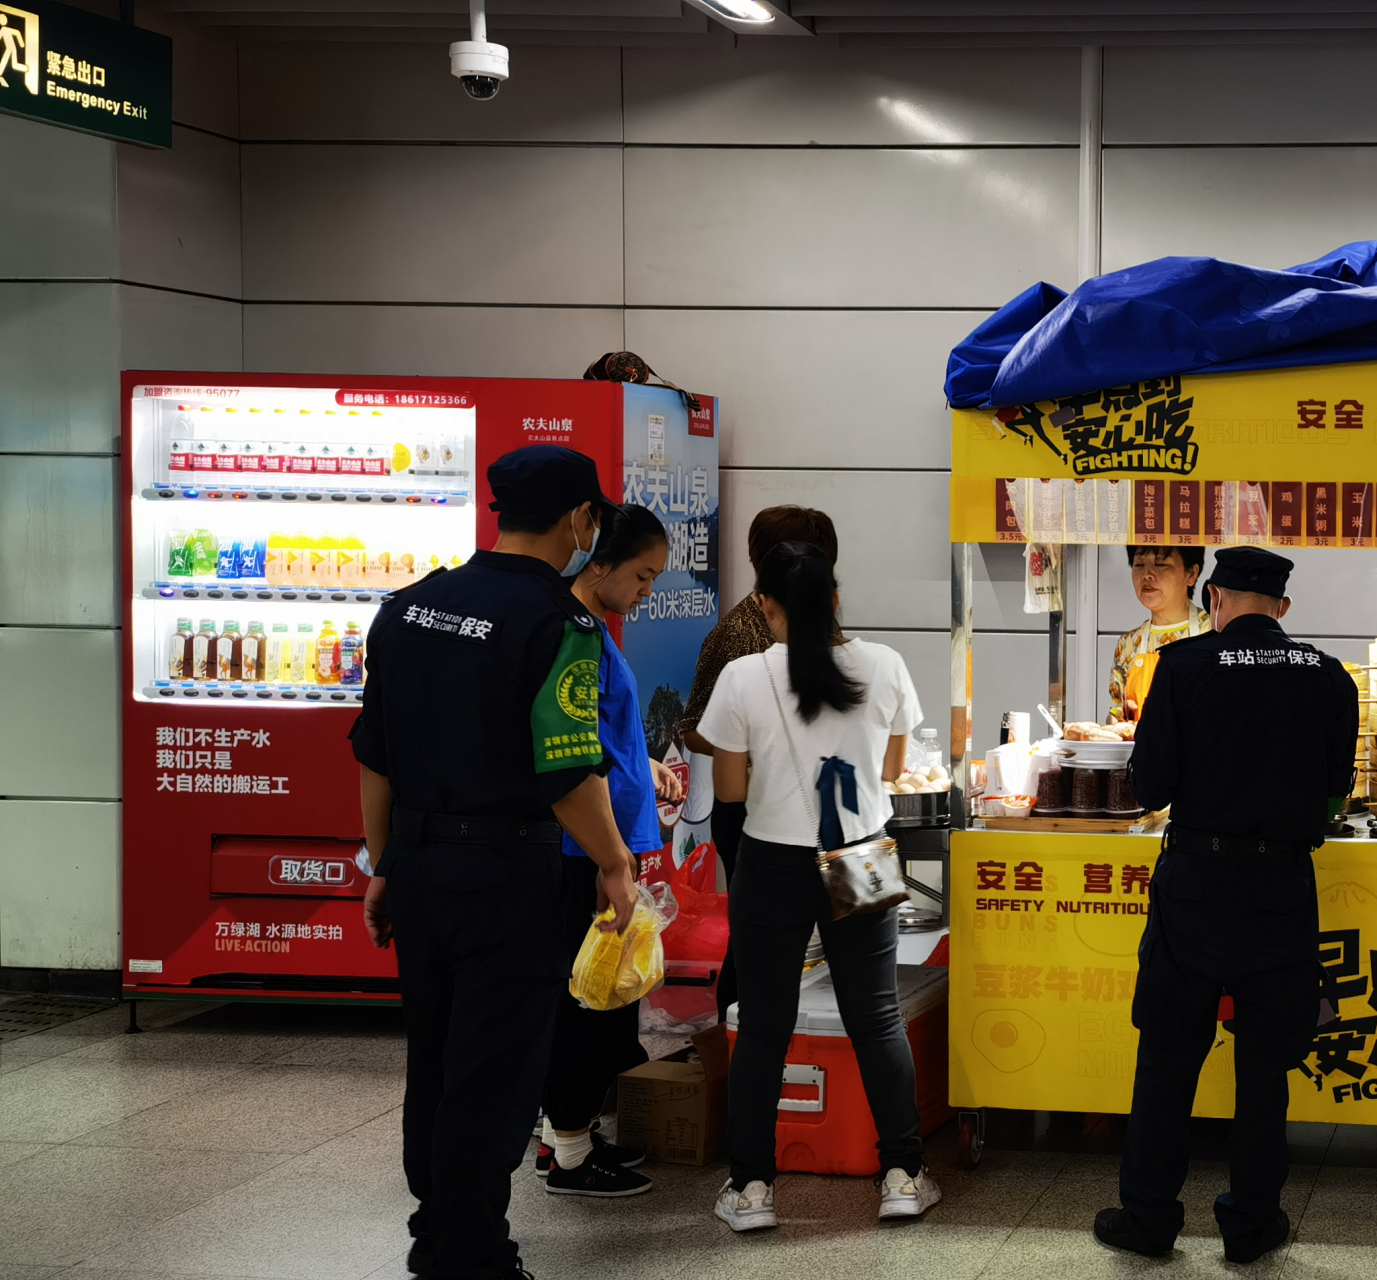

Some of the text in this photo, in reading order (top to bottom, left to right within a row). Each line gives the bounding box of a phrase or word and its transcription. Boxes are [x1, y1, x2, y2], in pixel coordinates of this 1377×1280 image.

[47, 51, 106, 87] 紧急出口
[47, 81, 148, 120] Emergency Exit
[522, 417, 573, 432] 农夫山泉
[1297, 399, 1364, 429] 安全
[1061, 396, 1195, 455] 安心吃
[1074, 444, 1196, 472] FIGHTING!
[623, 460, 710, 517] 农夫山泉
[1144, 485, 1156, 530] 梅干菜包
[1179, 486, 1191, 530] 马拉糕
[1249, 491, 1259, 526] 豆浆
[1281, 492, 1293, 527] 鸡蛋
[1352, 492, 1363, 528] 玉米
[1000, 533, 1022, 541] 3.5元
[1143, 535, 1157, 543] 3元
[1178, 536, 1192, 544] 3元
[1280, 537, 1294, 546] 2元
[1315, 538, 1328, 546] 3元
[402, 604, 437, 629] 车站
[458, 616, 493, 640] 保安
[1218, 649, 1255, 666] 车站
[1255, 649, 1286, 657] STATION
[1256, 655, 1286, 665] SECURITY
[1287, 649, 1321, 667] 保安
[156, 727, 271, 748] 我们不生产水
[156, 750, 232, 769] 我们只是
[156, 773, 290, 794] 大自然的搬运工
[279, 859, 346, 883] 取货口
[977, 860, 1150, 894] 安全 营养
[976, 898, 1044, 912] SAFETY
[215, 922, 343, 940] 万绿湖 水源地实拍
[972, 913, 1058, 933] BUNS
[215, 938, 290, 953] LIVE-ACTION
